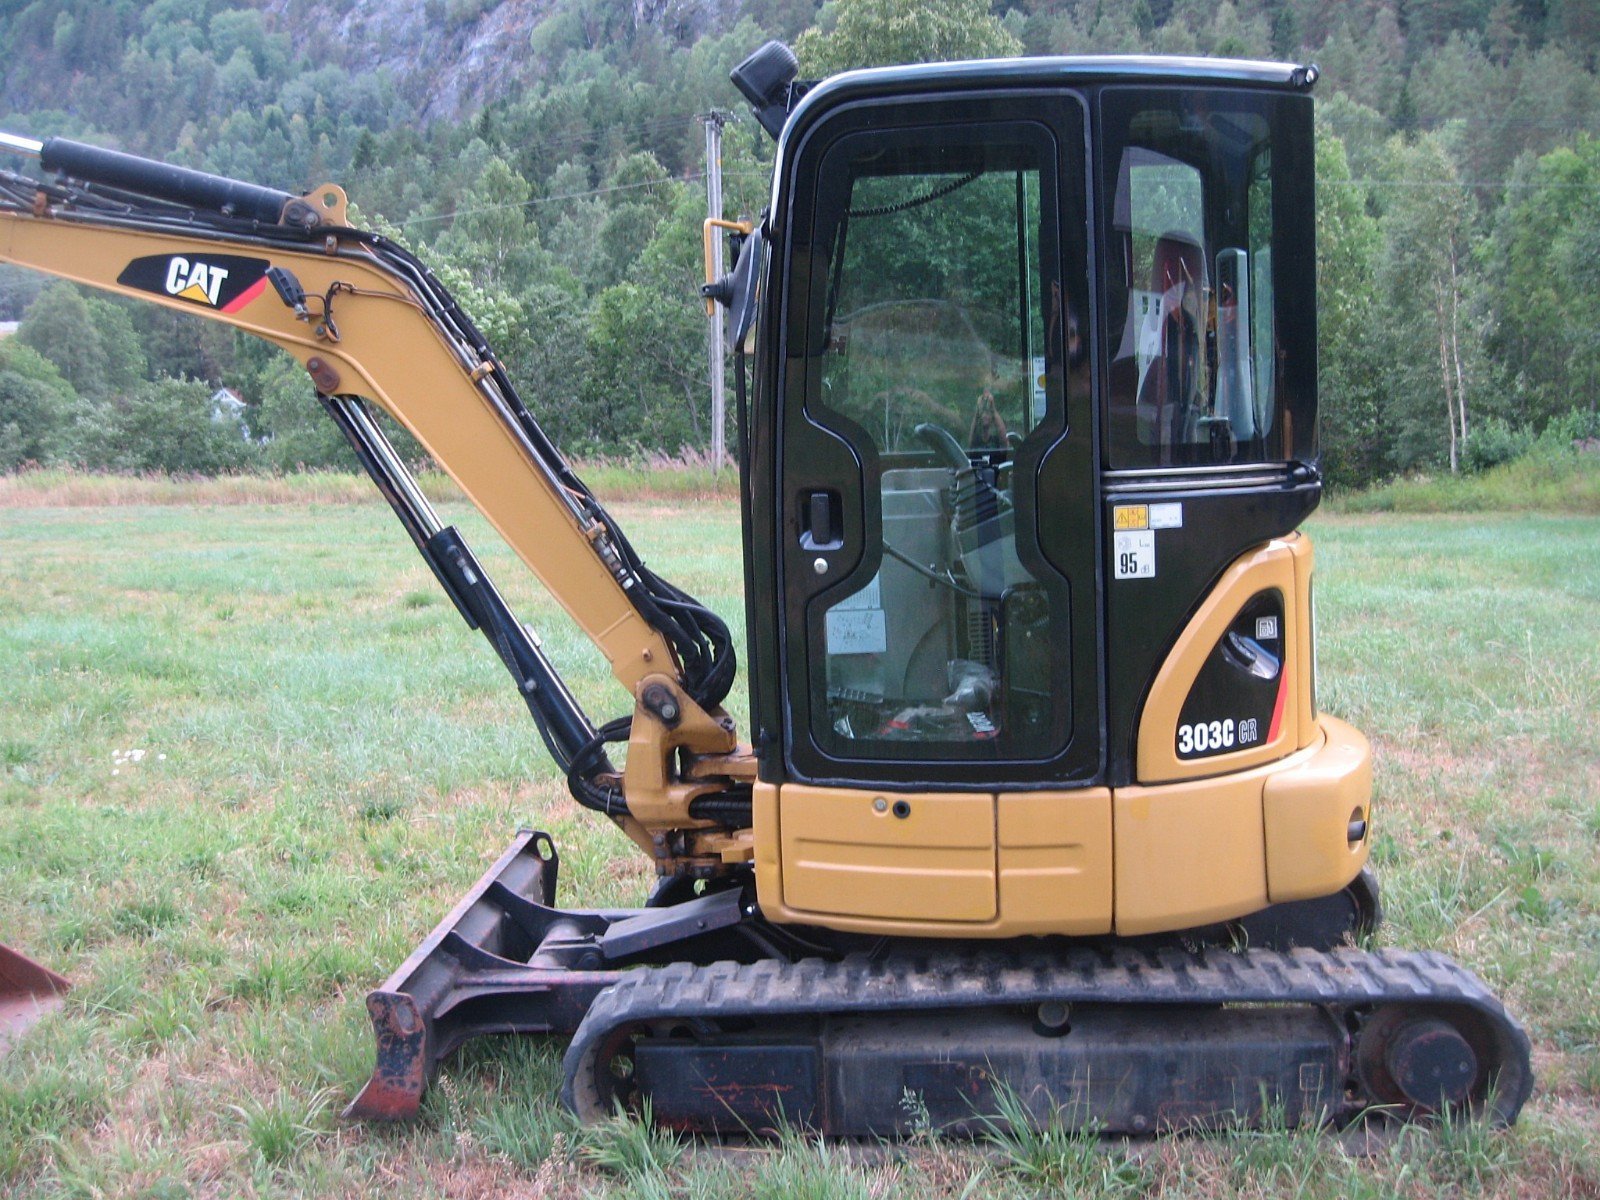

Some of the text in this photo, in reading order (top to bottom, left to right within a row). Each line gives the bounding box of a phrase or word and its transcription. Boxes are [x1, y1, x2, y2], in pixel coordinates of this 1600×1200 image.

[166, 257, 229, 305] CAT
[1120, 552, 1138, 574] 95
[1178, 718, 1258, 753] 303C CR
